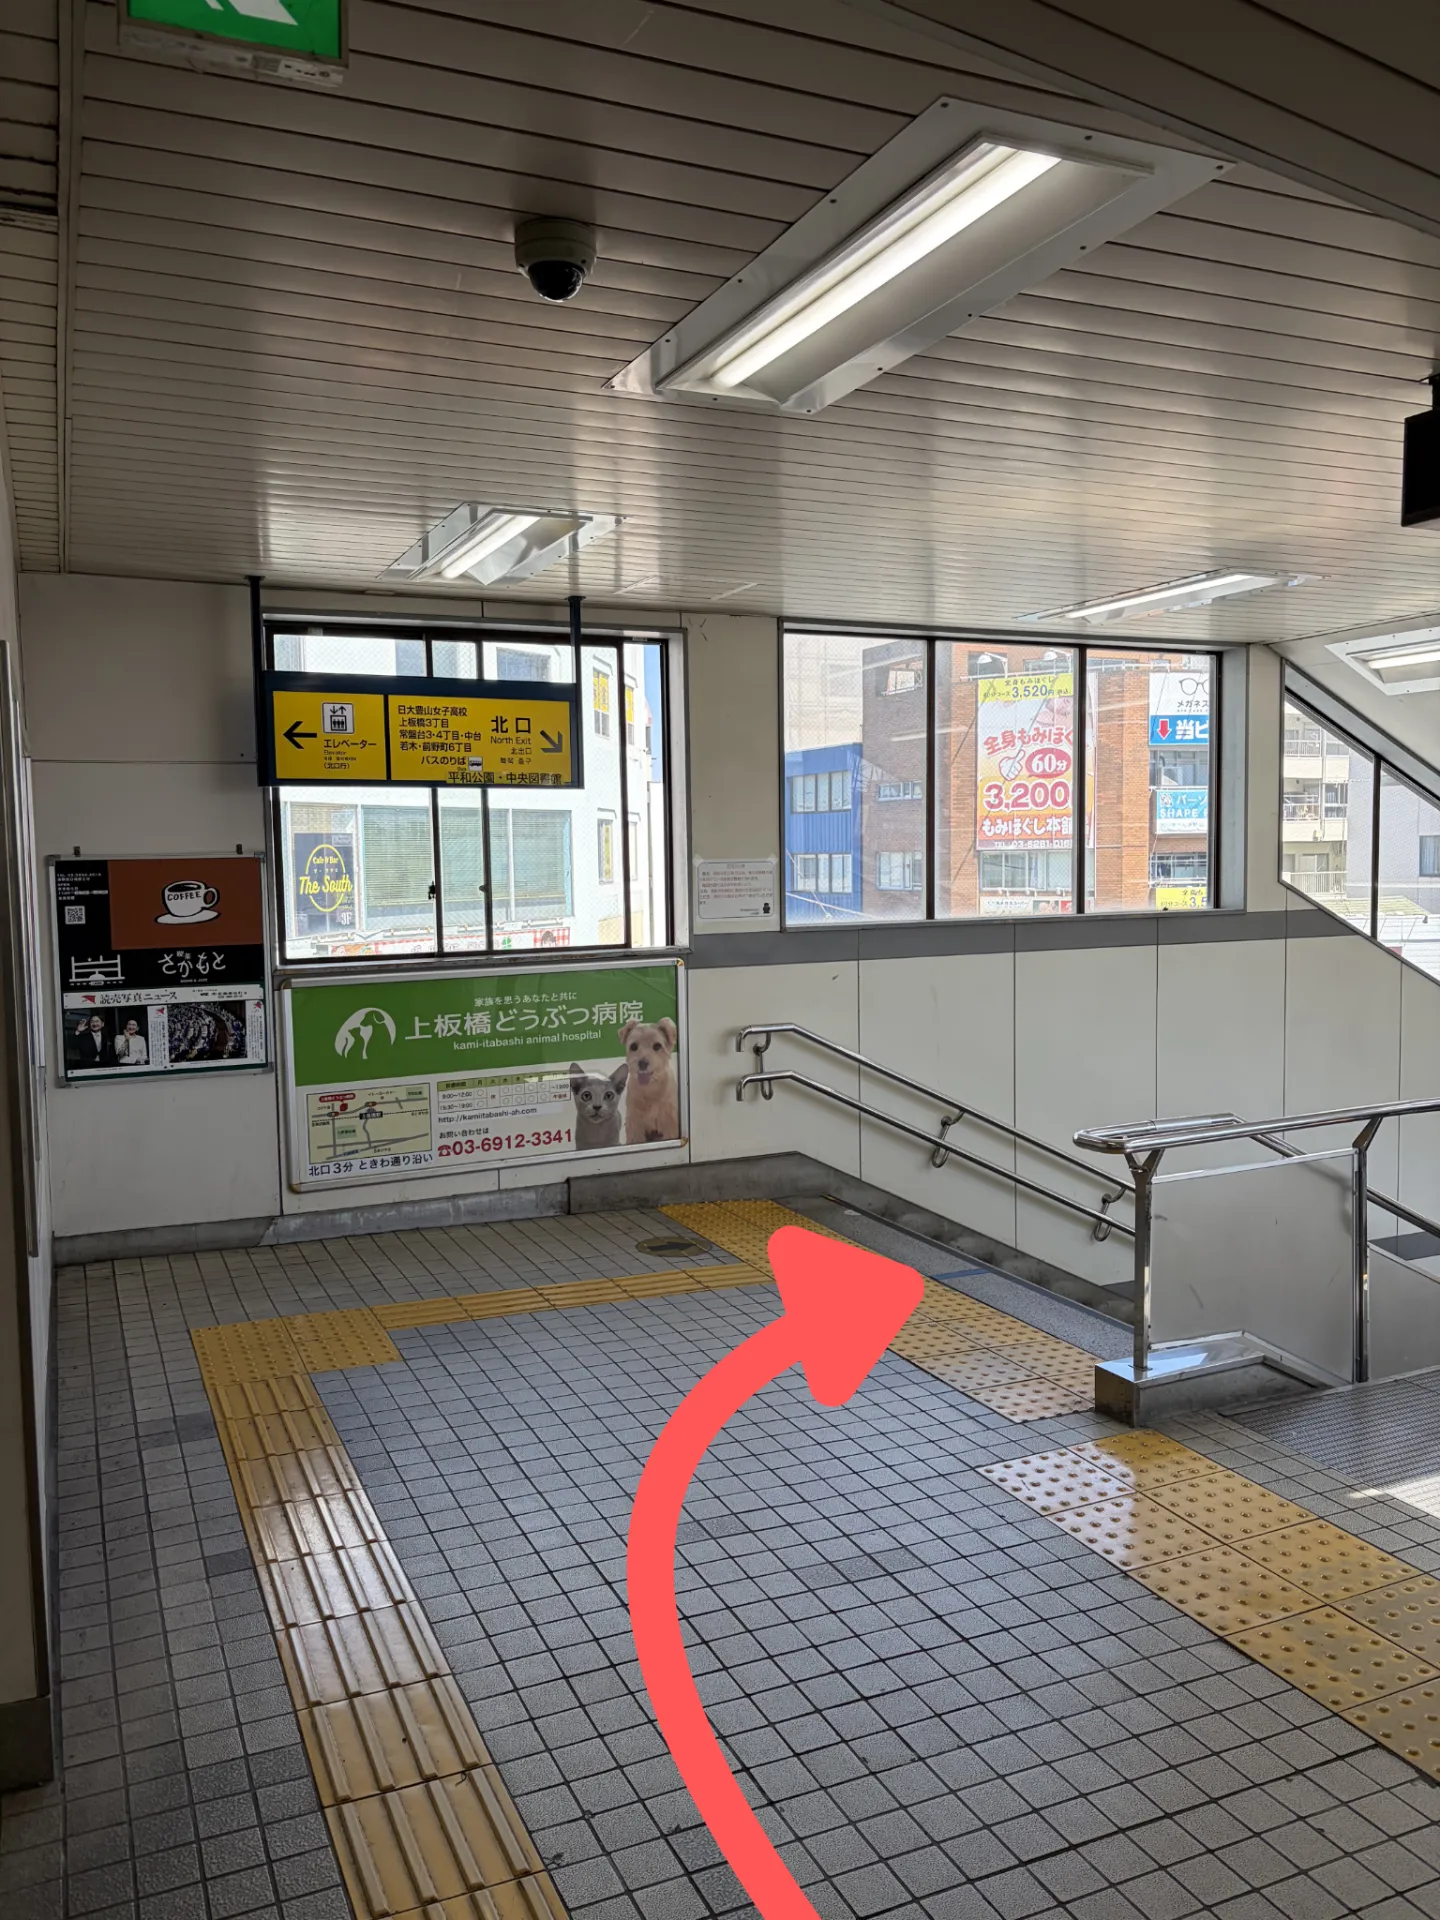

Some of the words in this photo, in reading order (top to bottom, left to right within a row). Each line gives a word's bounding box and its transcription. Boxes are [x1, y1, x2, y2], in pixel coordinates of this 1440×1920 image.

[398, 705, 468, 717] 日大豊山女子高校
[399, 717, 449, 728] 上板橋3丁目
[490, 715, 532, 734] 北口
[399, 729, 482, 741] 常盤台3・4丁目・中台
[490, 736, 513, 745] North
[516, 736, 532, 745] Exit
[323, 738, 377, 750] エレベーター
[400, 741, 472, 753] 若木・前野町6丁目
[421, 756, 467, 766] バスのりば
[1031, 753, 1068, 773] 60分
[1160, 808, 1199, 818] SHAPE
[299, 876, 320, 895] The
[321, 874, 353, 893] South
[167, 891, 202, 902] COFFEE
[157, 951, 227, 978] さかもと
[99, 991, 178, 1005] 読売写真ニュース
[474, 991, 577, 1007] 家族を思うあなたと共に
[404, 1000, 644, 1040] 上板橋どうぶつ病院
[453, 1037, 524, 1051] kami-itabashi
[526, 1033, 559, 1045] animal
[562, 1030, 602, 1043] hospital
[438, 1107, 537, 1123] http://kamiitabashi-ah.com
[439, 1127, 489, 1139] お問い合わせは
[452, 1128, 572, 1156] 03-6912-3341
[358, 1154, 433, 1171] ときわ通り沿い
